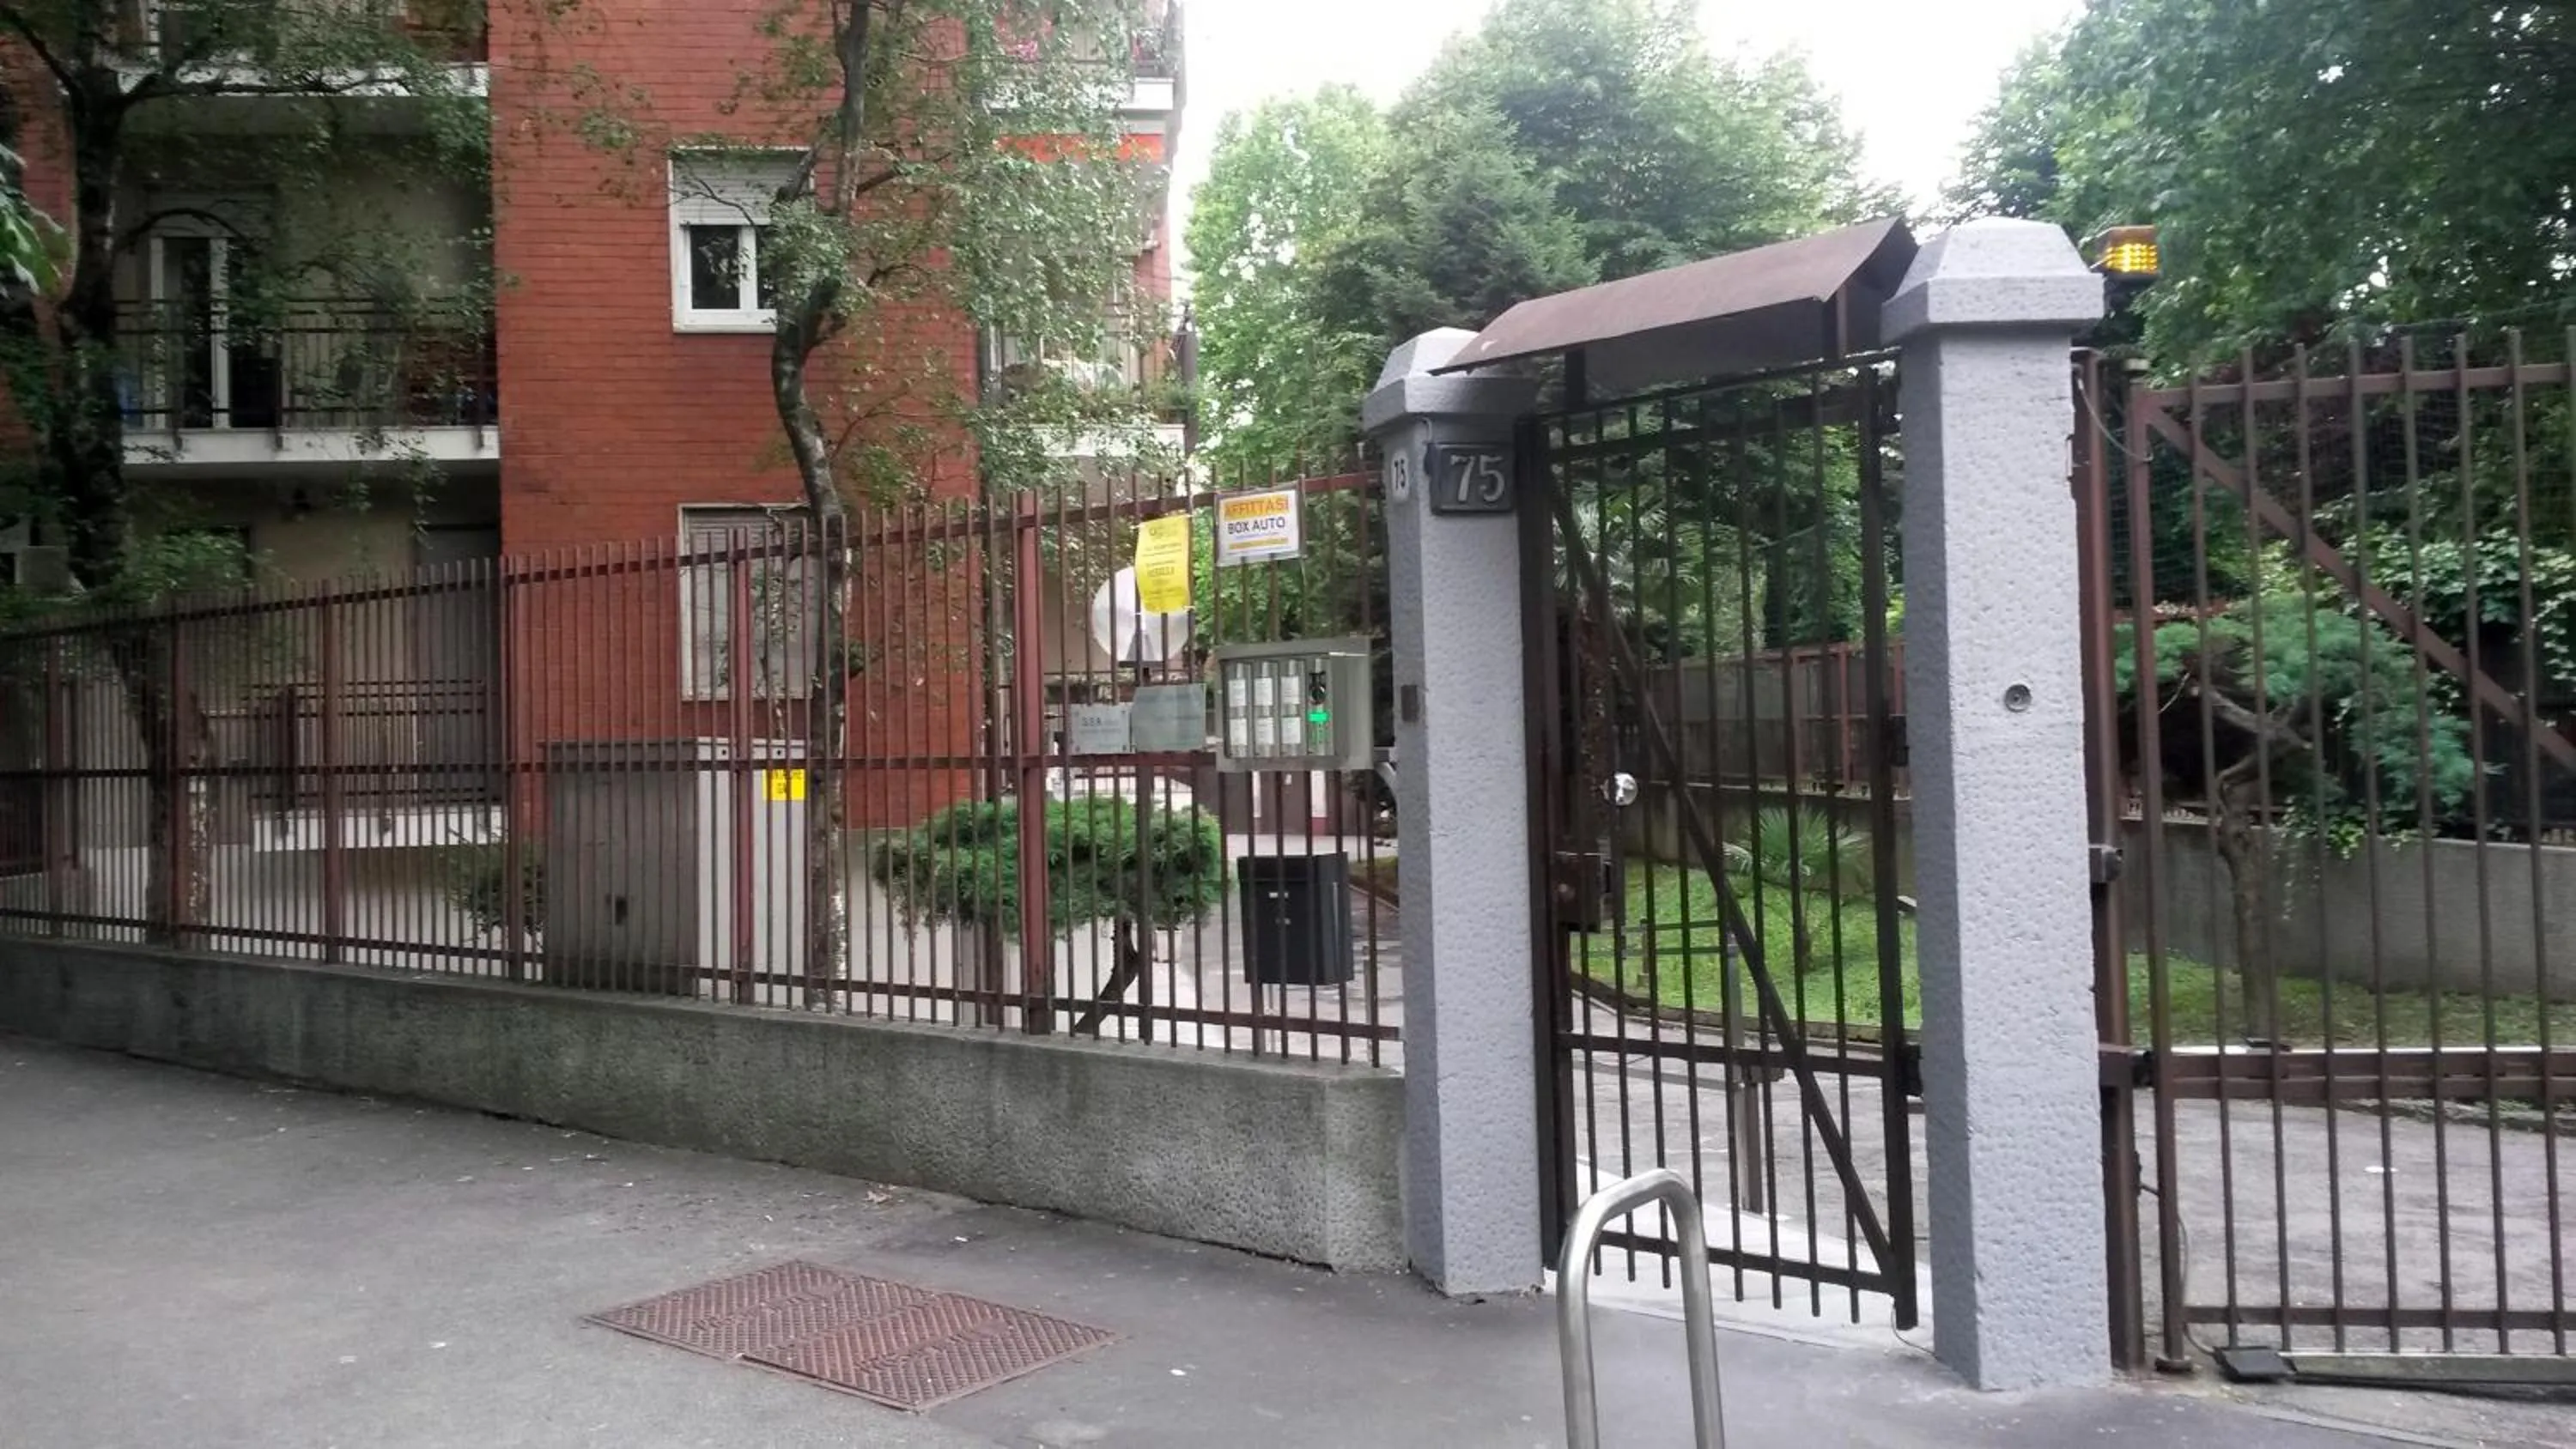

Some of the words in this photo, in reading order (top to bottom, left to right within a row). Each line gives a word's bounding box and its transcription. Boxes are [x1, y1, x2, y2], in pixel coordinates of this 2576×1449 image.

[1450, 454, 1504, 502] 75
[1224, 497, 1289, 517] AFFITTASI
[1228, 521, 1250, 534] BOX
[1252, 516, 1285, 530] AUTO
